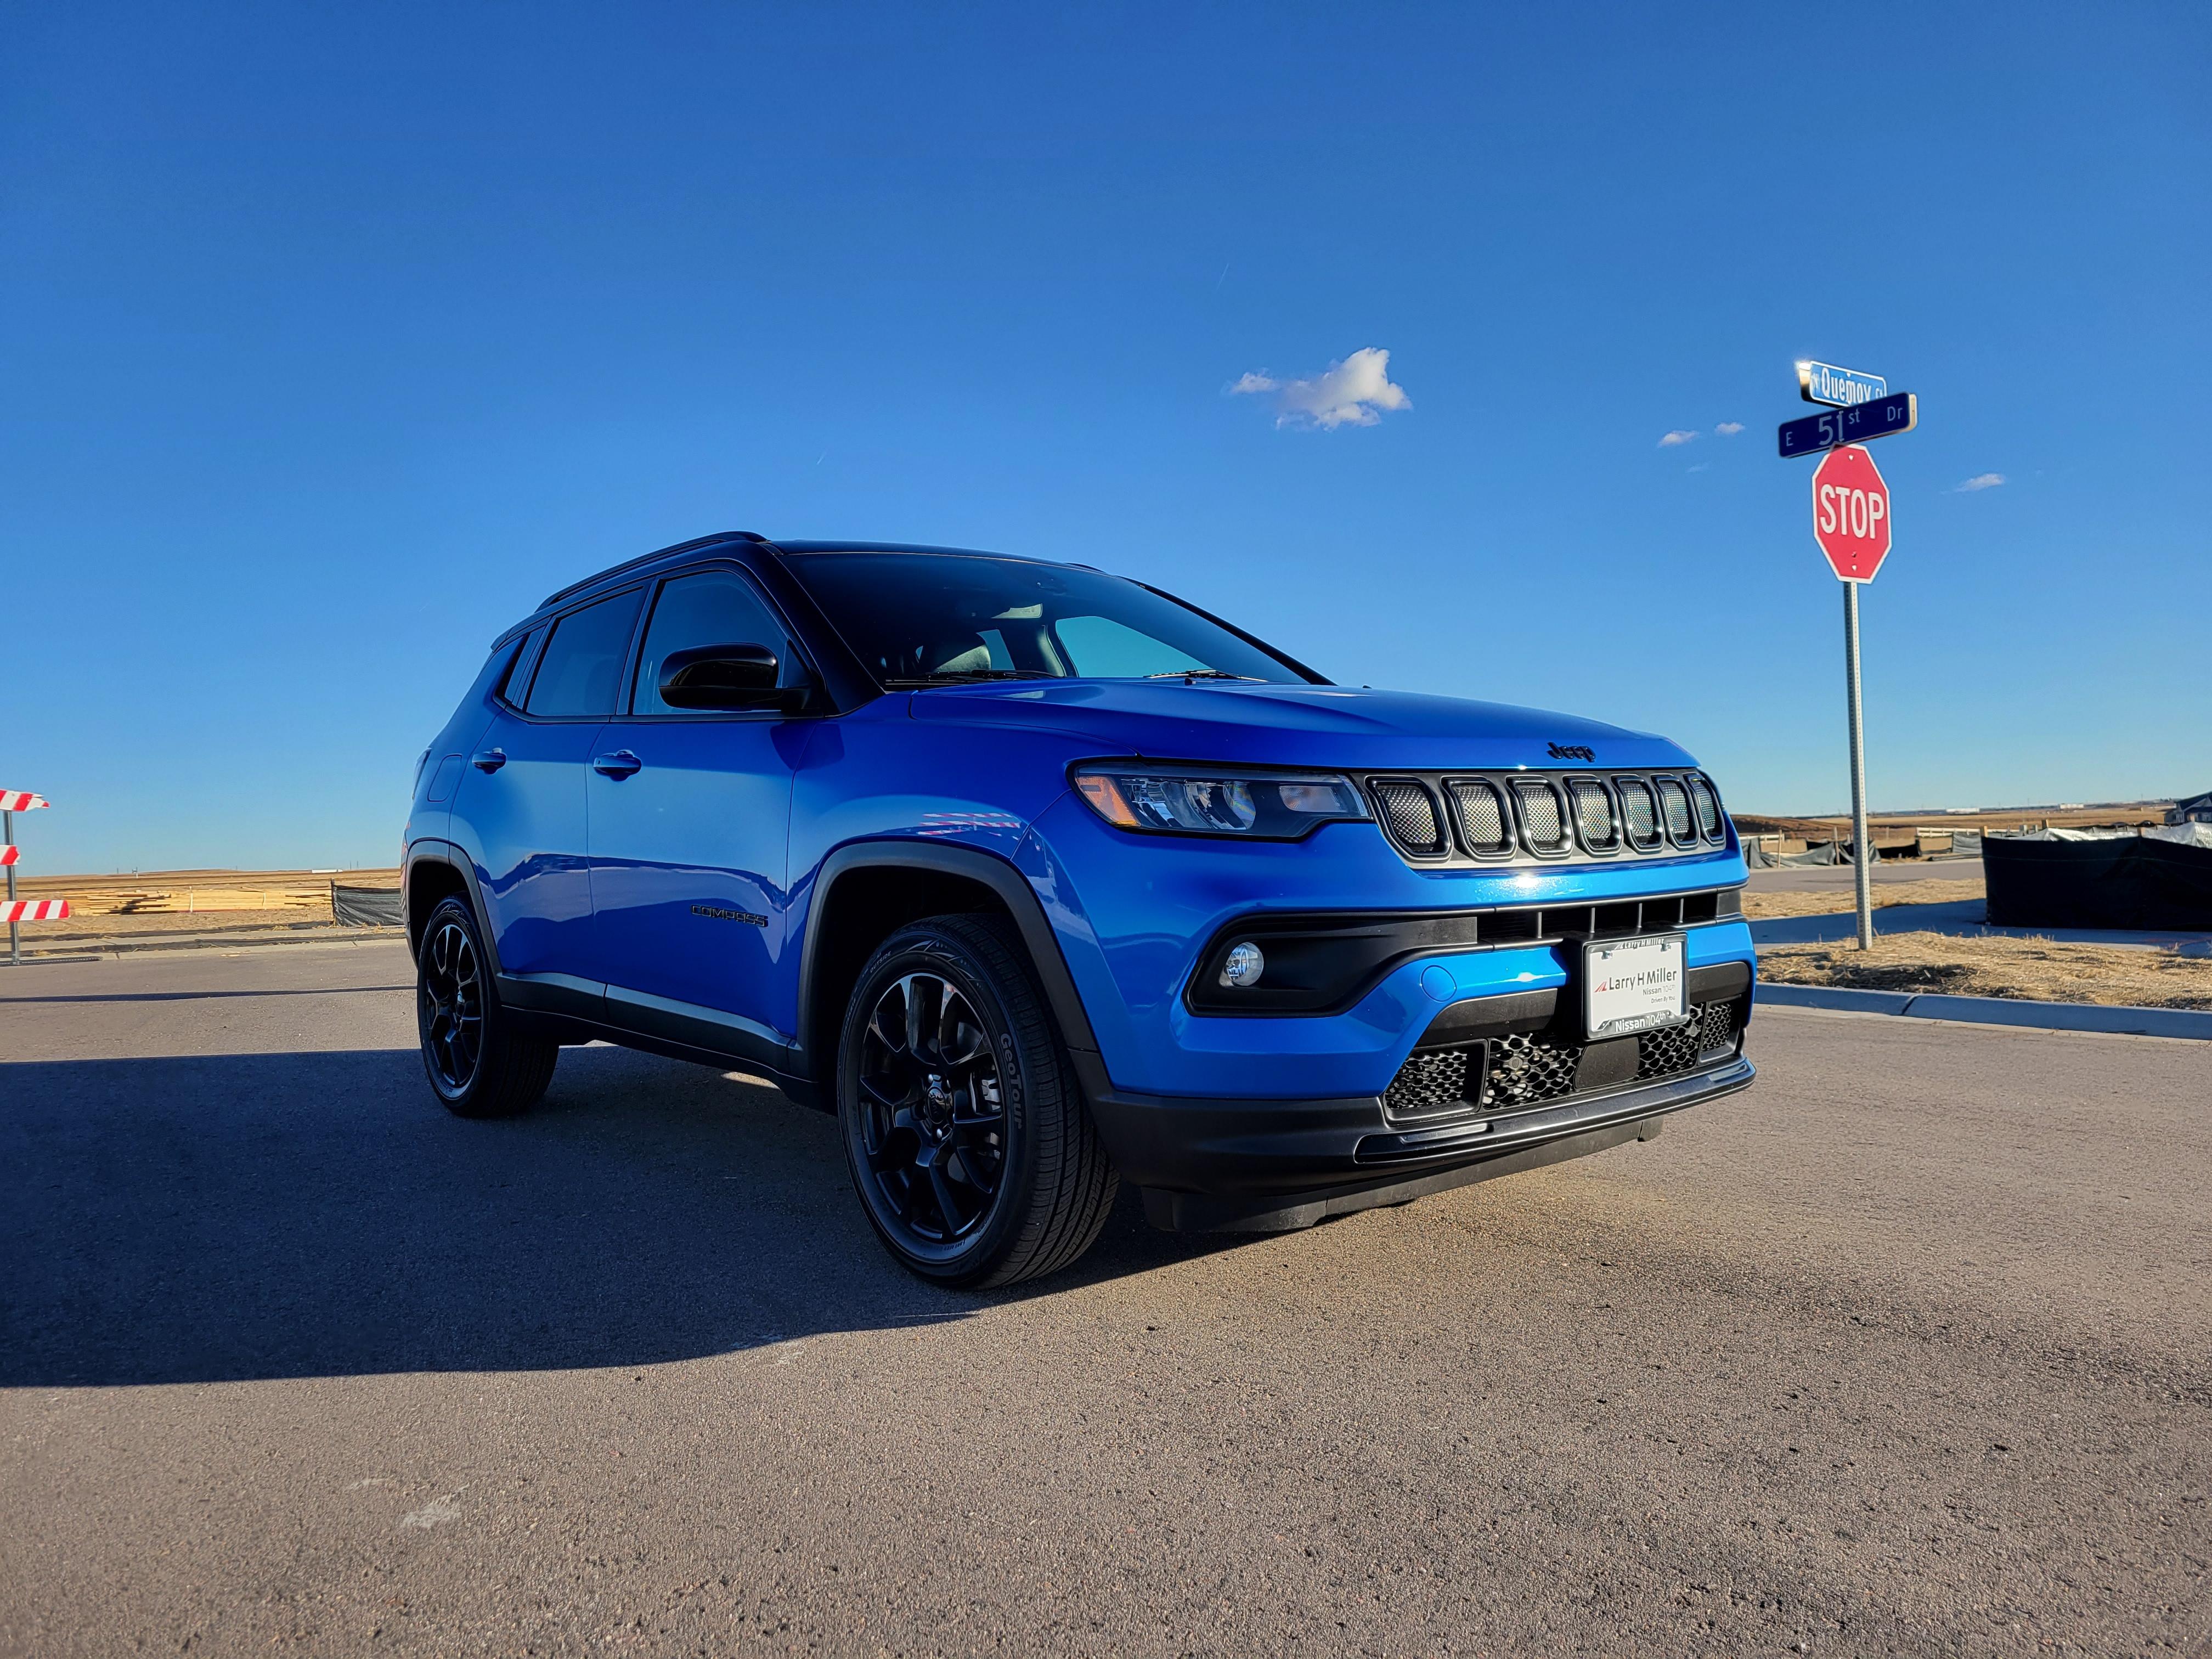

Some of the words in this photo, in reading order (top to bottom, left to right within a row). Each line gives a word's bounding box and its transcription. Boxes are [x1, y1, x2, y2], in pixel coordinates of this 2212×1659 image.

[1821, 368, 1871, 404] Quemoy
[1786, 432, 1793, 446] E
[1819, 408, 1860, 445] 51st
[1887, 406, 1903, 421] Dr
[1820, 484, 1884, 539] STOP
[1547, 742, 1596, 763] Jeep
[691, 905, 768, 927] COMPASS
[1624, 940, 1641, 949] Larry
[1646, 938, 1664, 946] Miller
[870, 951, 891, 973] OUTSIDE
[1609, 977, 1635, 990] Larry
[1638, 972, 1645, 986] H
[1646, 967, 1677, 985] Miller
[1615, 1019, 1645, 1032] Nissan
[1646, 1012, 1666, 1026] 104th
[1000, 1033, 1023, 1129] GeoTour
